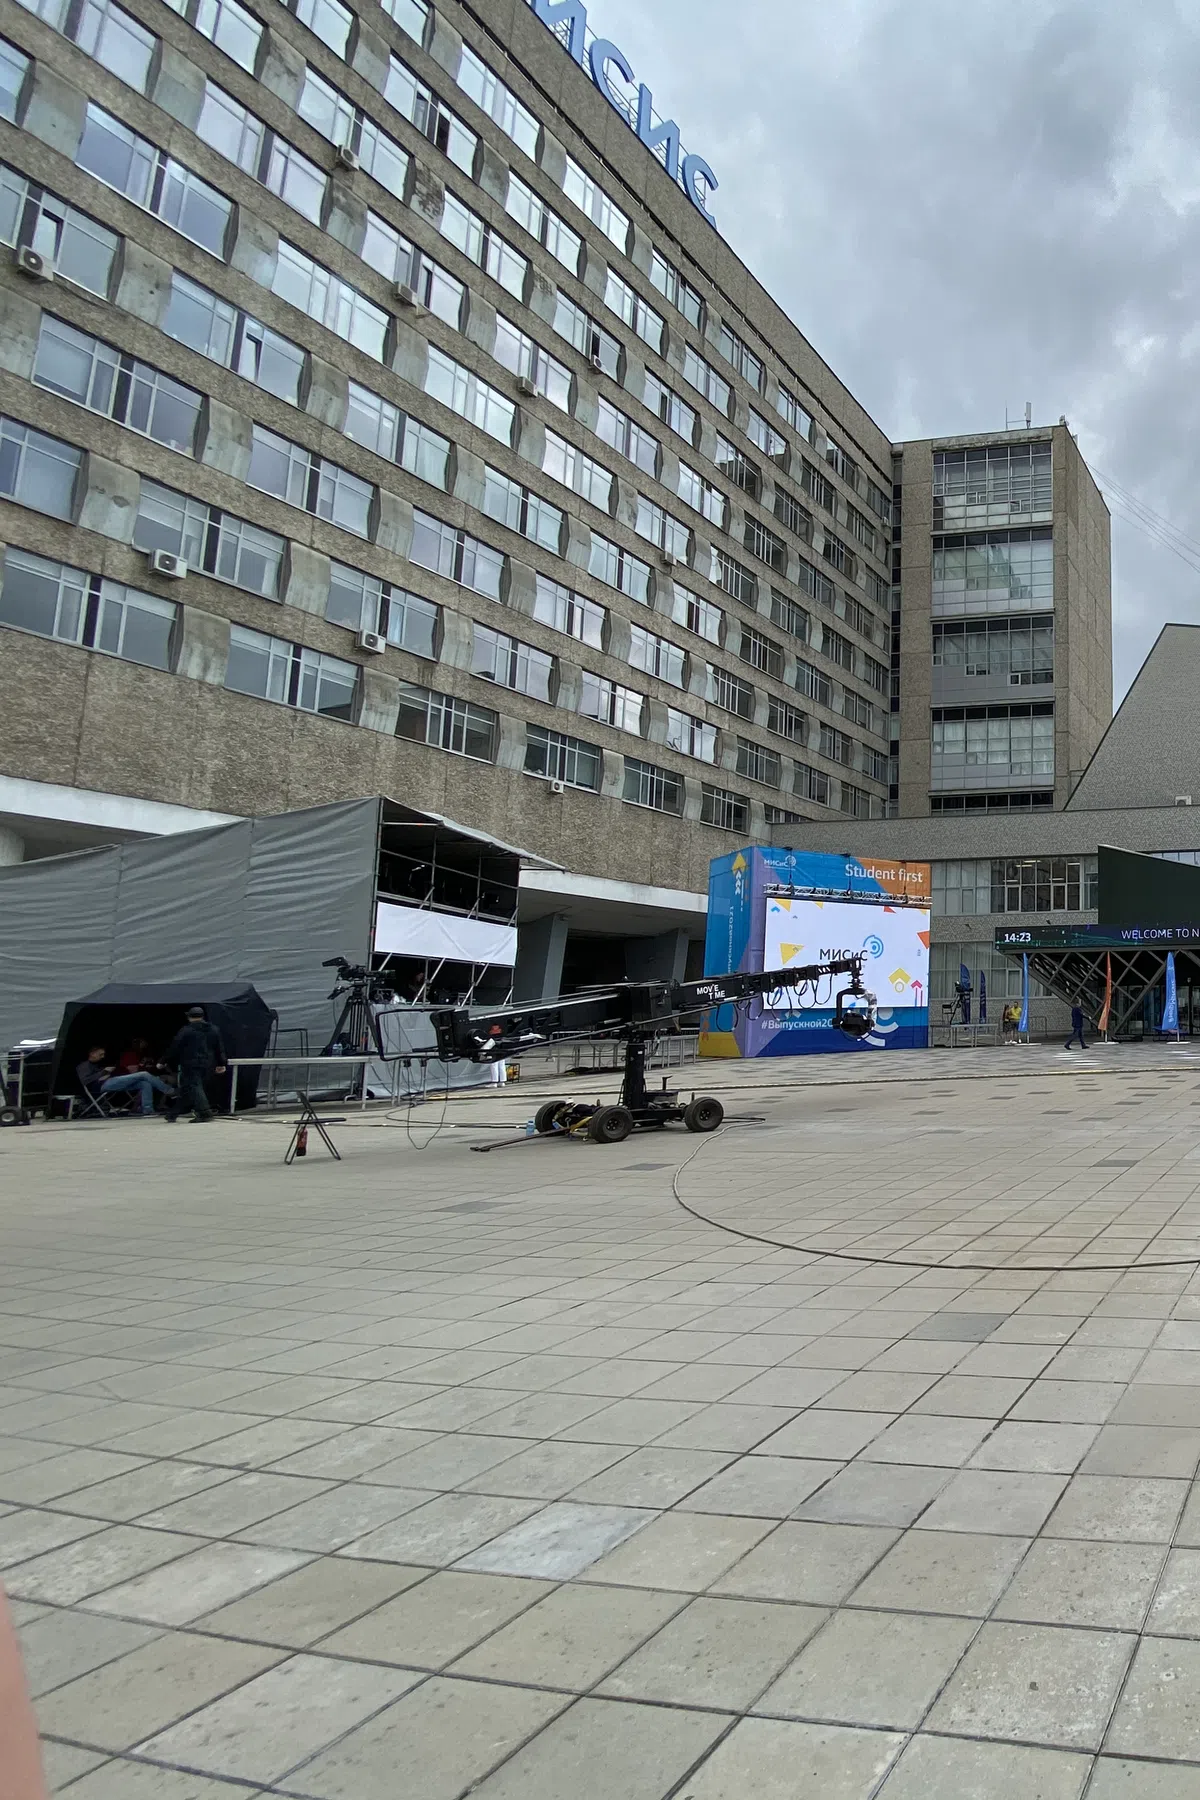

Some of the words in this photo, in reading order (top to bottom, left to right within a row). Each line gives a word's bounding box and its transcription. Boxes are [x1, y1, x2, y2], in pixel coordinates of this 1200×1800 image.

[845, 863, 896, 881] Student
[898, 868, 923, 883] first
[1004, 932, 1032, 943] 14:23
[1121, 928, 1173, 940] WELCOME
[1175, 928, 1190, 938] TO
[819, 948, 869, 962] МИСиС
[761, 1017, 835, 1031] #Выпускной20
